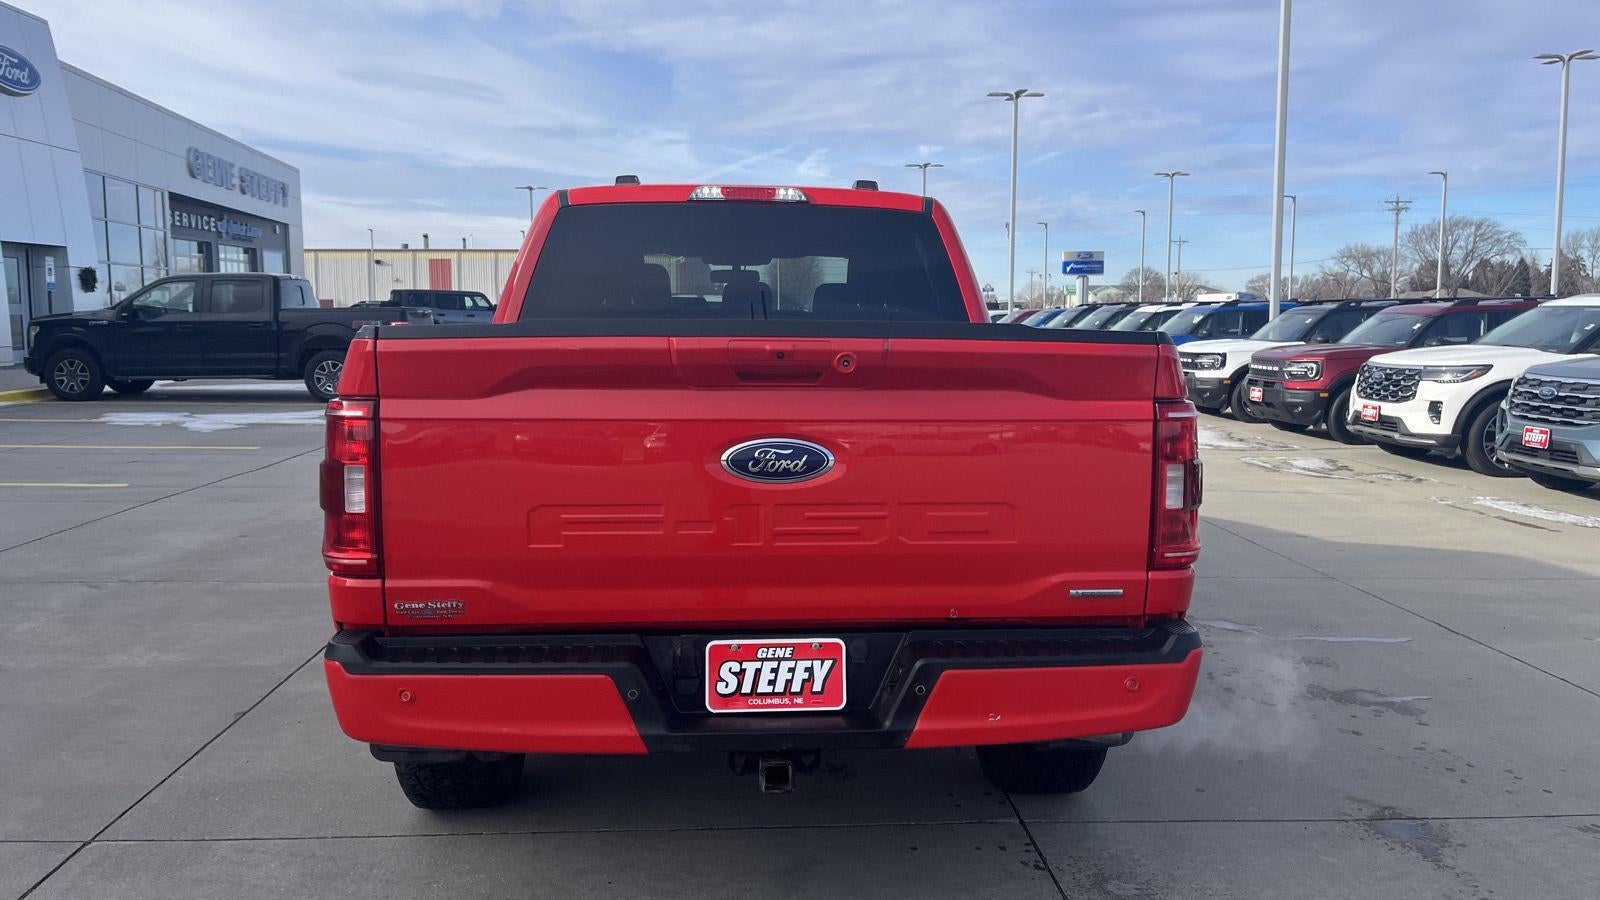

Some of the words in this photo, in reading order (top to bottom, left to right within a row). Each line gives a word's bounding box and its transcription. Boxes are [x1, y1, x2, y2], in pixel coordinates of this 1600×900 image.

[748, 448, 808, 472] Ford
[527, 502, 1020, 548] F-150
[428, 600, 464, 609] Steffy
[757, 647, 793, 658] GENE
[716, 659, 834, 695] STEFFY
[748, 697, 791, 705] COLUMBUS,
